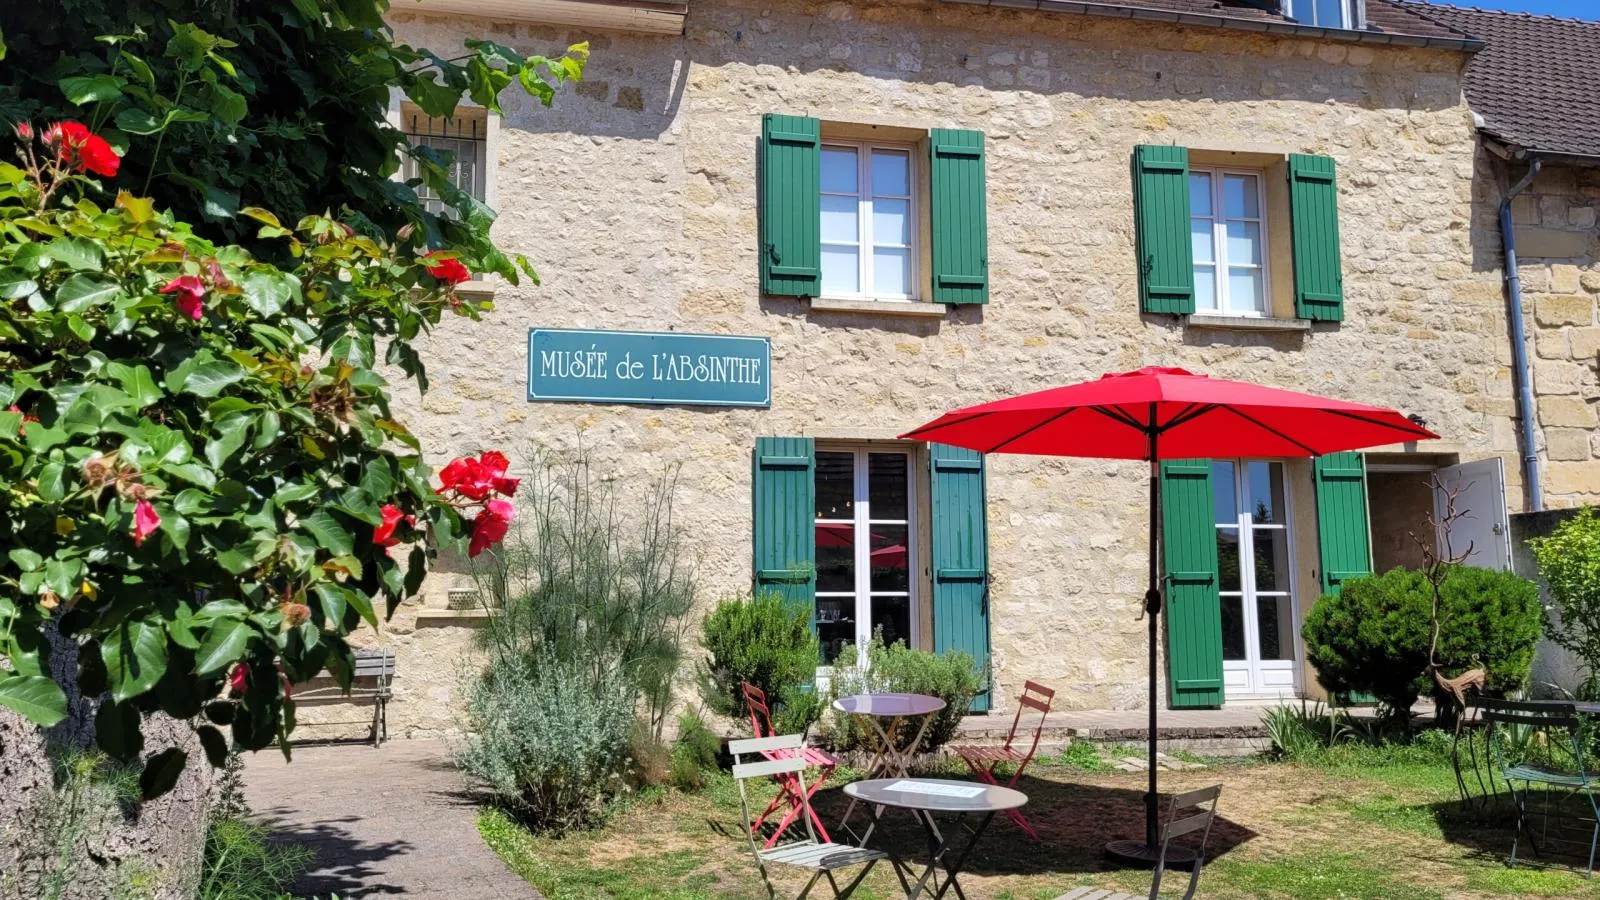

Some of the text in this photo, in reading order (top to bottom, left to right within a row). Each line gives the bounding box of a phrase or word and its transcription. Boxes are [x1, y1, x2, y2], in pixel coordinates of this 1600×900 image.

[541, 344, 761, 384] MUSÉE de L'ABSINTHE
